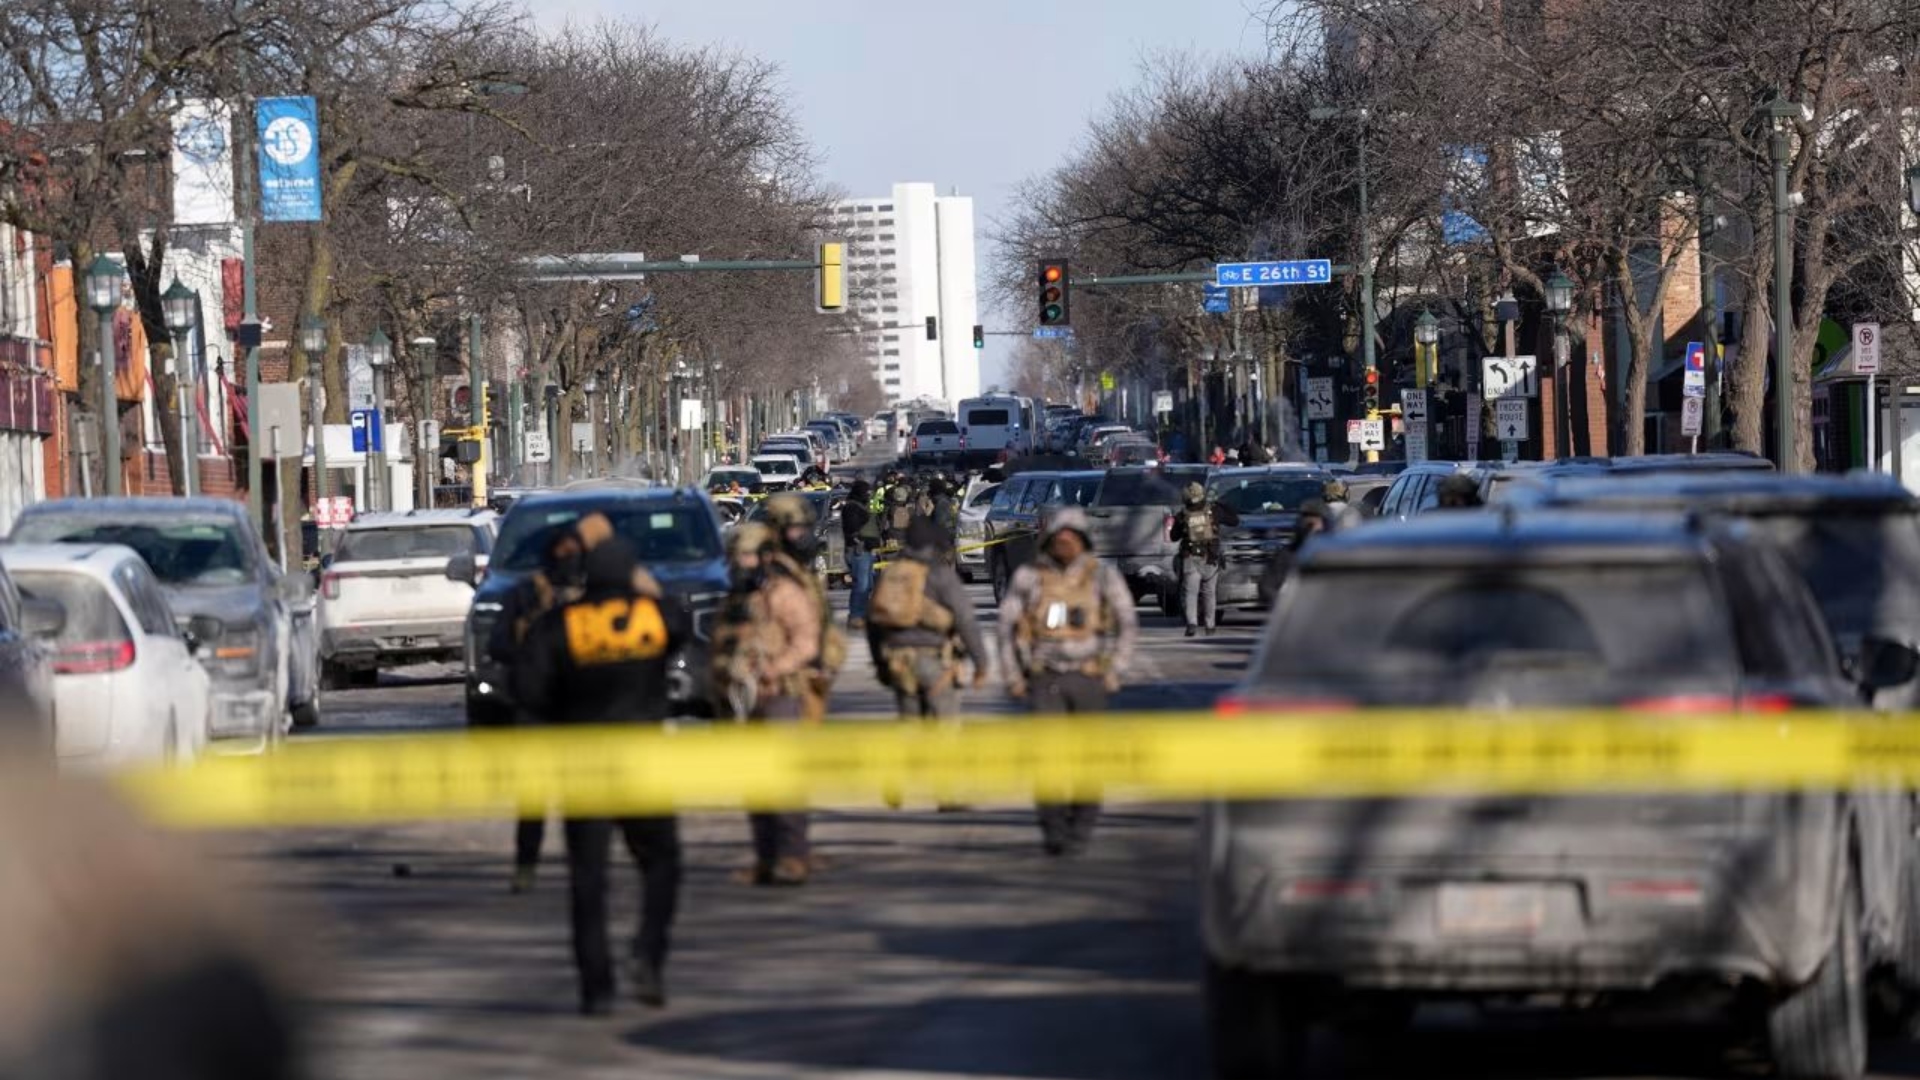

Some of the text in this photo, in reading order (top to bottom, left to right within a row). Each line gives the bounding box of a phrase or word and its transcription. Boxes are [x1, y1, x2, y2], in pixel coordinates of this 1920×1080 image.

[1242, 264, 1326, 281] E 26th St
[1406, 392, 1424, 400] ONE
[1406, 401, 1424, 409] WAY
[1500, 403, 1524, 411] TRUCK
[1500, 413, 1524, 421] ROUTE
[564, 597, 668, 664] BCA
